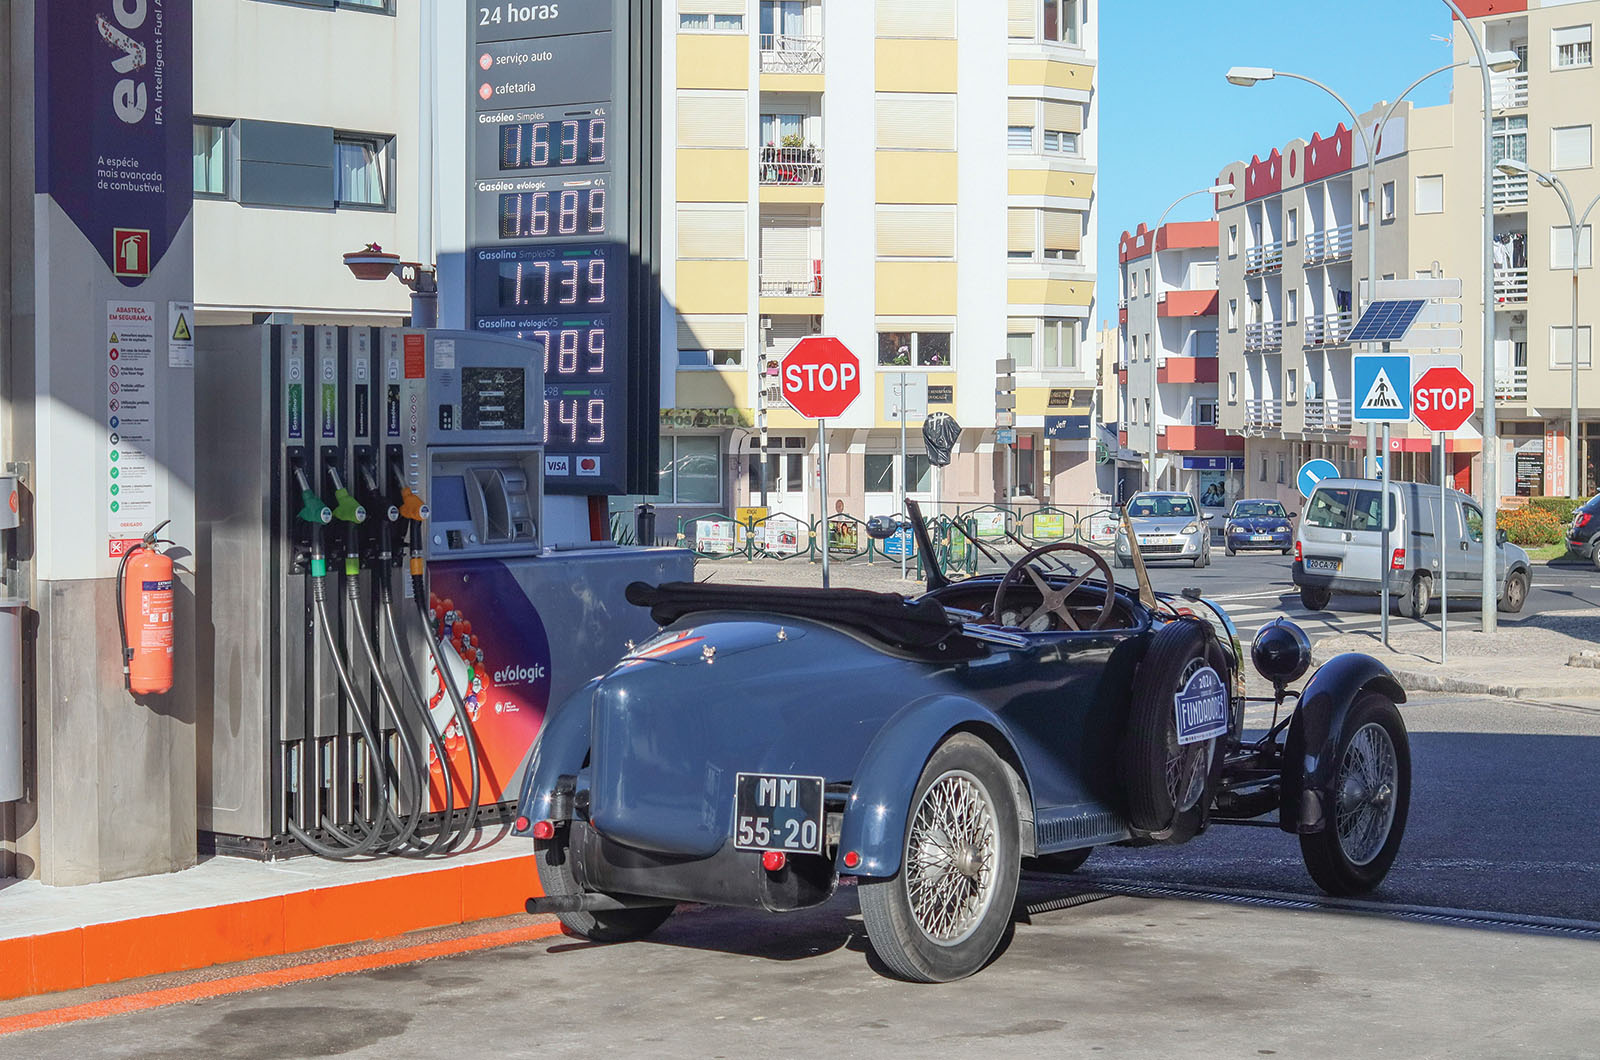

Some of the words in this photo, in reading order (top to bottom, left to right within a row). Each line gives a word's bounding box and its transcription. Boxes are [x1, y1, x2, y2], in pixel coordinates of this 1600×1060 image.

[479, 6, 502, 26] 24
[507, 3, 559, 23] horas
[154, 9, 162, 35] Fuel
[496, 53, 528, 65] serviço
[531, 51, 553, 62] auto
[154, 39, 164, 101] Intelligent
[495, 81, 536, 94] cafetaria
[154, 106, 162, 124] IFA
[479, 112, 514, 123] Gasóleo
[516, 112, 545, 122] Simples
[97, 155, 105, 165] A
[106, 157, 139, 168] espécie
[97, 168, 118, 178] mais
[120, 171, 162, 181] avançada
[97, 179, 109, 190] de
[110, 181, 165, 193] combustível.
[478, 182, 514, 192] Gasóleo
[516, 181, 546, 191] evologic
[514, 188, 606, 237] 1.689
[478, 250, 517, 260] Gasolina
[515, 259, 606, 304] 1.739
[116, 306, 145, 315] ABASTEÇA
[118, 315, 153, 323] SEGURANÇA
[478, 318, 516, 328] Gasolina
[785, 363, 856, 393] STOP
[1416, 388, 1472, 411] STOP
[547, 461, 567, 471] VISA
[494, 662, 545, 684] evologic
[1199, 674, 1213, 689] 2024
[758, 777, 798, 808] MM
[738, 816, 817, 849] 55-20
